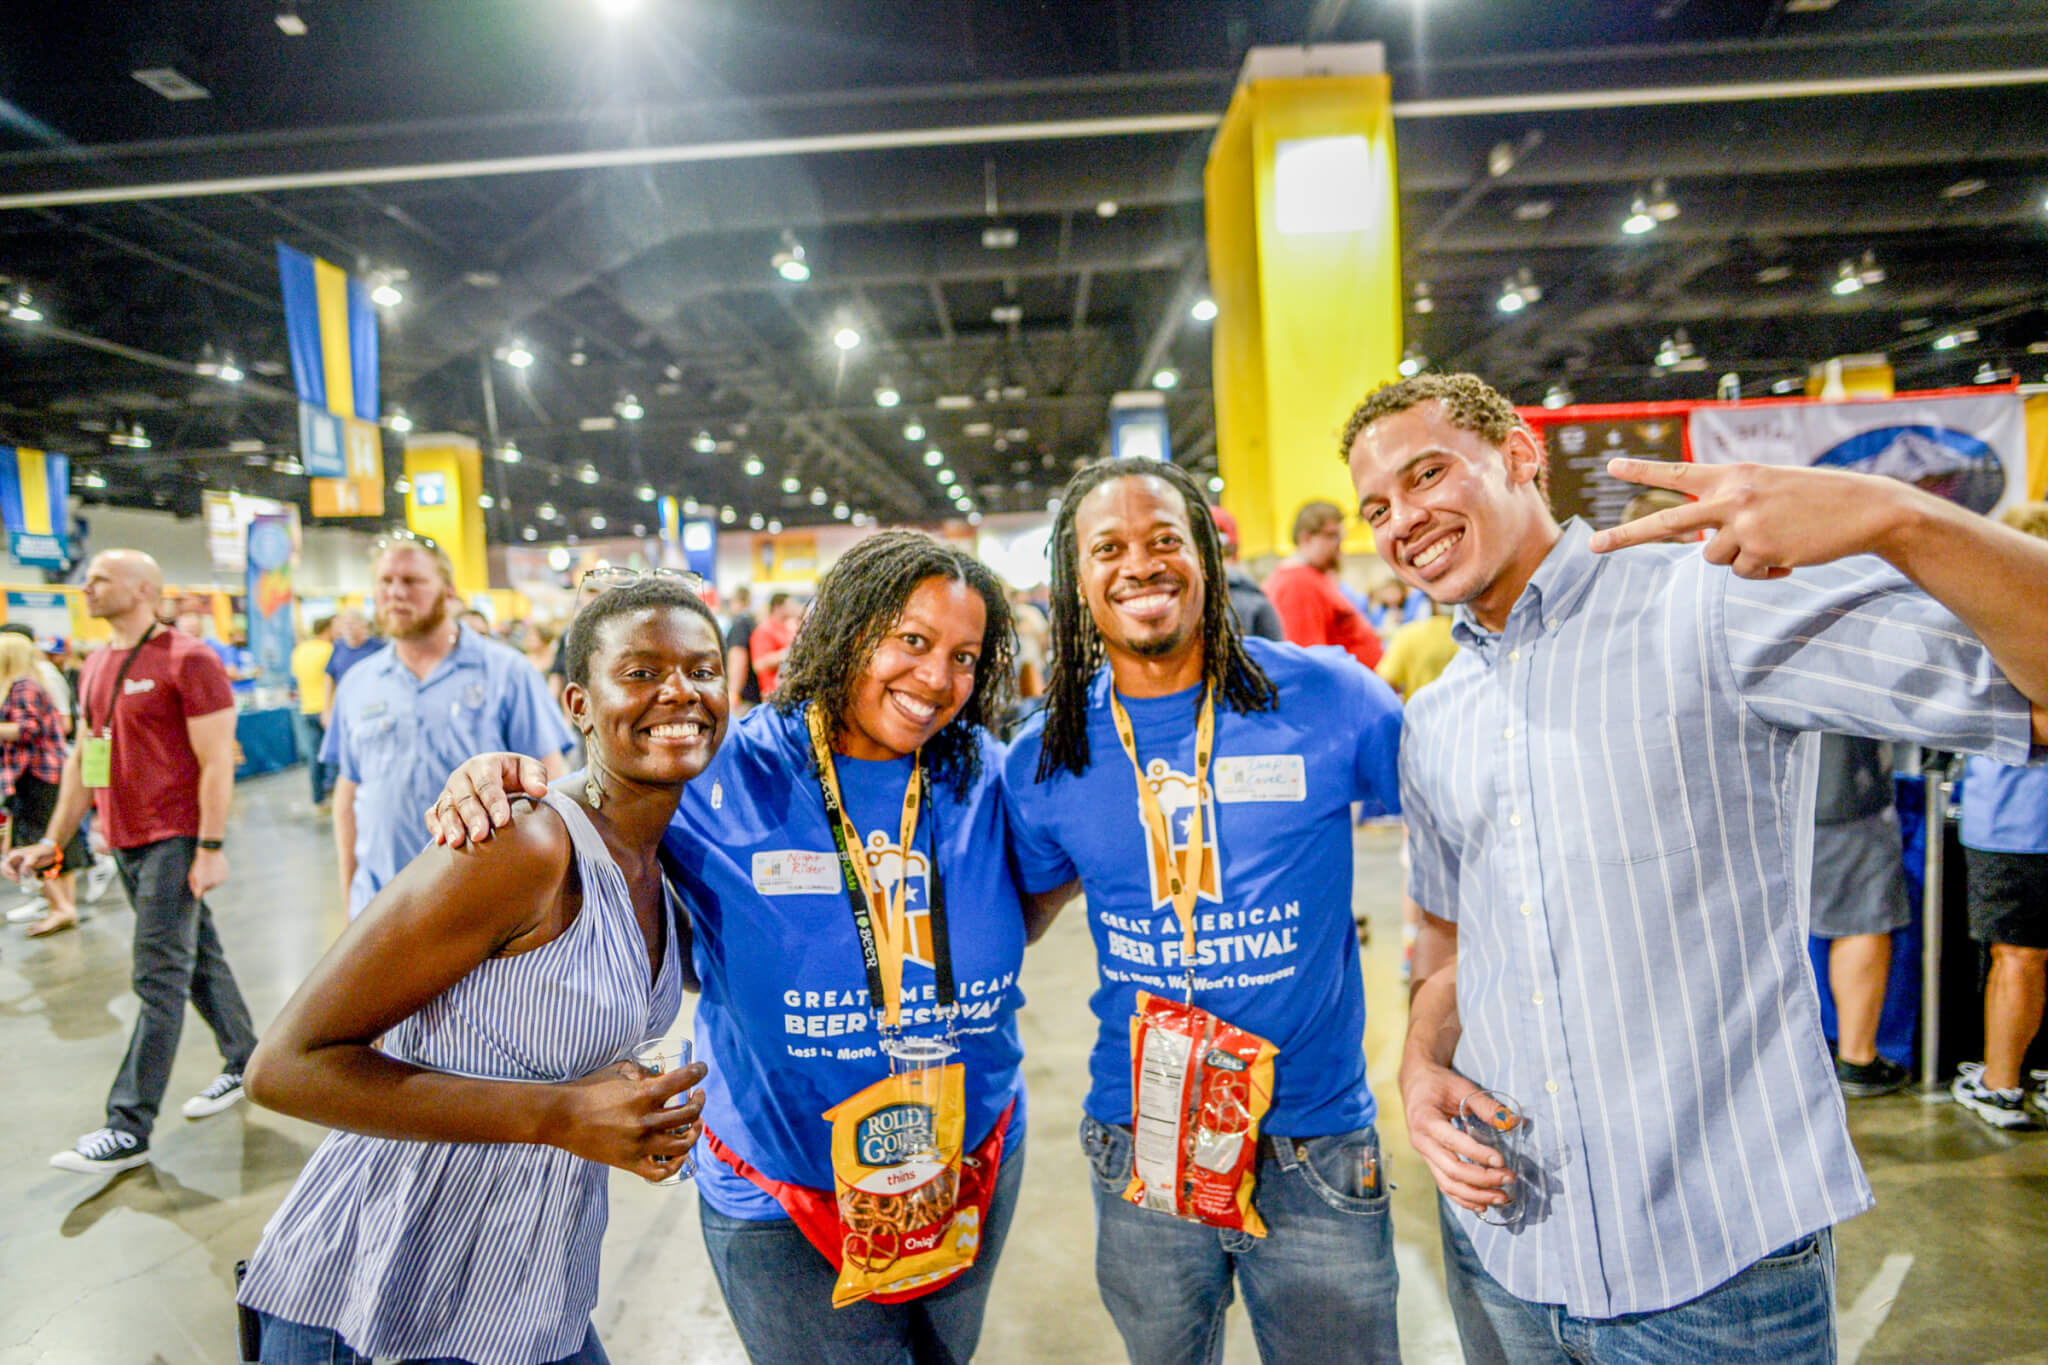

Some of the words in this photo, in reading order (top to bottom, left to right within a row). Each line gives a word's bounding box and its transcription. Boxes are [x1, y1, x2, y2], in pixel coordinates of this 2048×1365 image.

[1100, 911, 1151, 935] GREAT
[1108, 931, 1157, 966] BEER
[783, 989, 868, 1008] GREAT
[899, 972, 1014, 1003] MEICAN
[784, 1012, 868, 1038] BEER
[787, 1045, 817, 1058] Less
[867, 1107, 923, 1137] ROLD
[887, 1170, 916, 1186] thins
